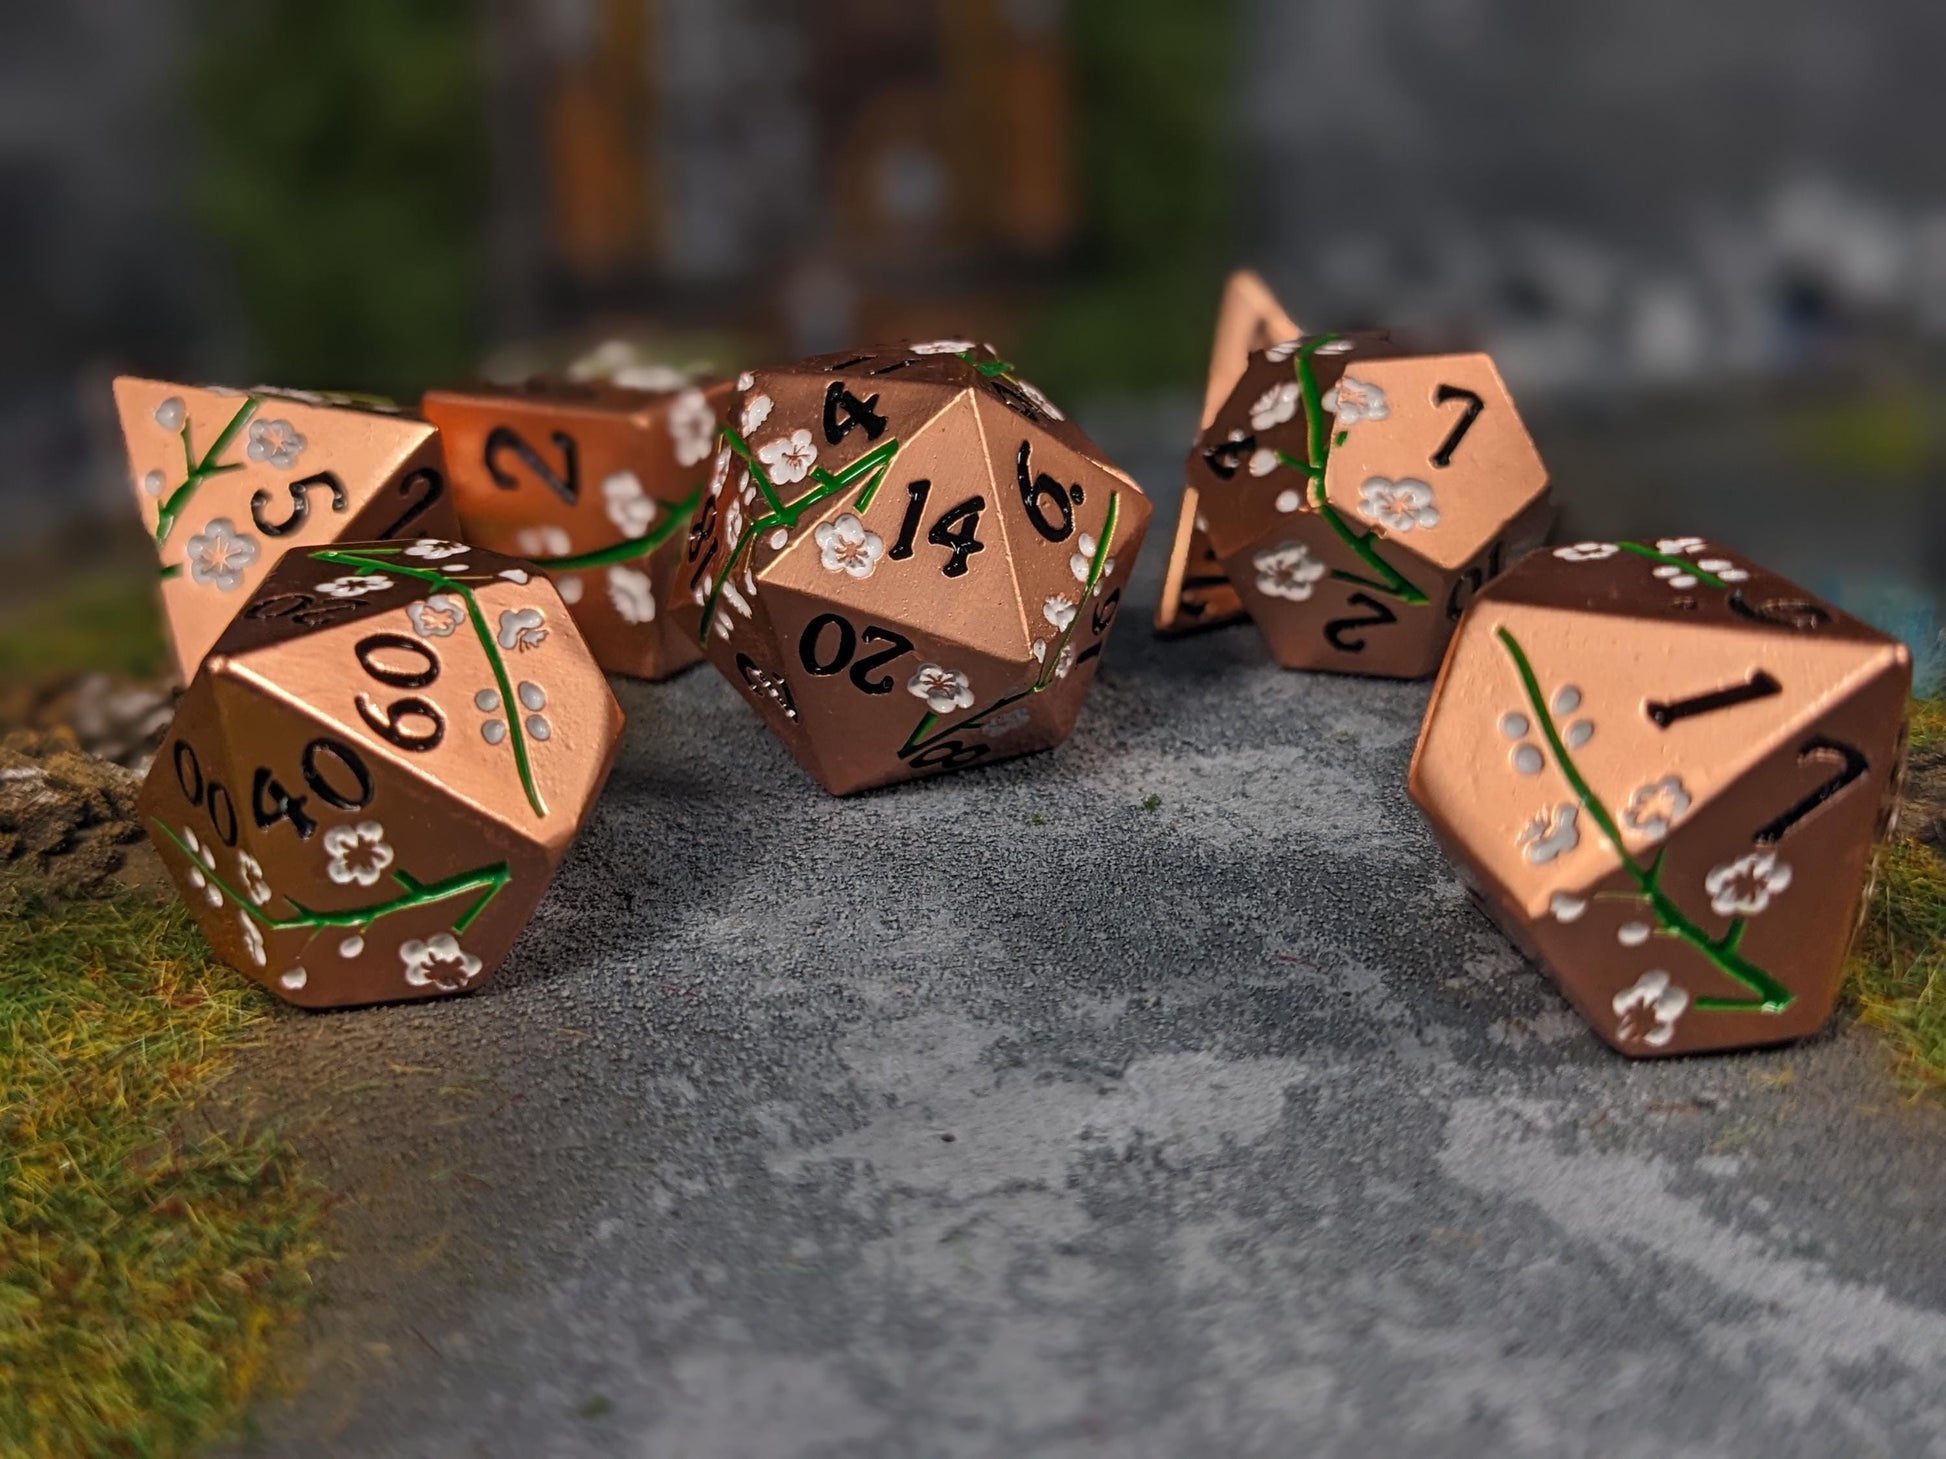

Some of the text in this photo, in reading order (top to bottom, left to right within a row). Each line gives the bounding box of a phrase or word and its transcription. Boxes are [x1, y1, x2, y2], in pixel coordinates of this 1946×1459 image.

[822, 380, 889, 445] 4
[1432, 383, 1486, 469] 7
[250, 470, 348, 537] 5
[484, 425, 581, 507] 2
[888, 478, 987, 579] 14
[799, 613, 914, 695] 20
[1323, 592, 1397, 652] 2
[355, 633, 446, 752] 60
[1642, 667, 1783, 730] 1
[173, 739, 237, 847] 00
[252, 738, 374, 839] 40
[1752, 736, 1870, 851] 7
